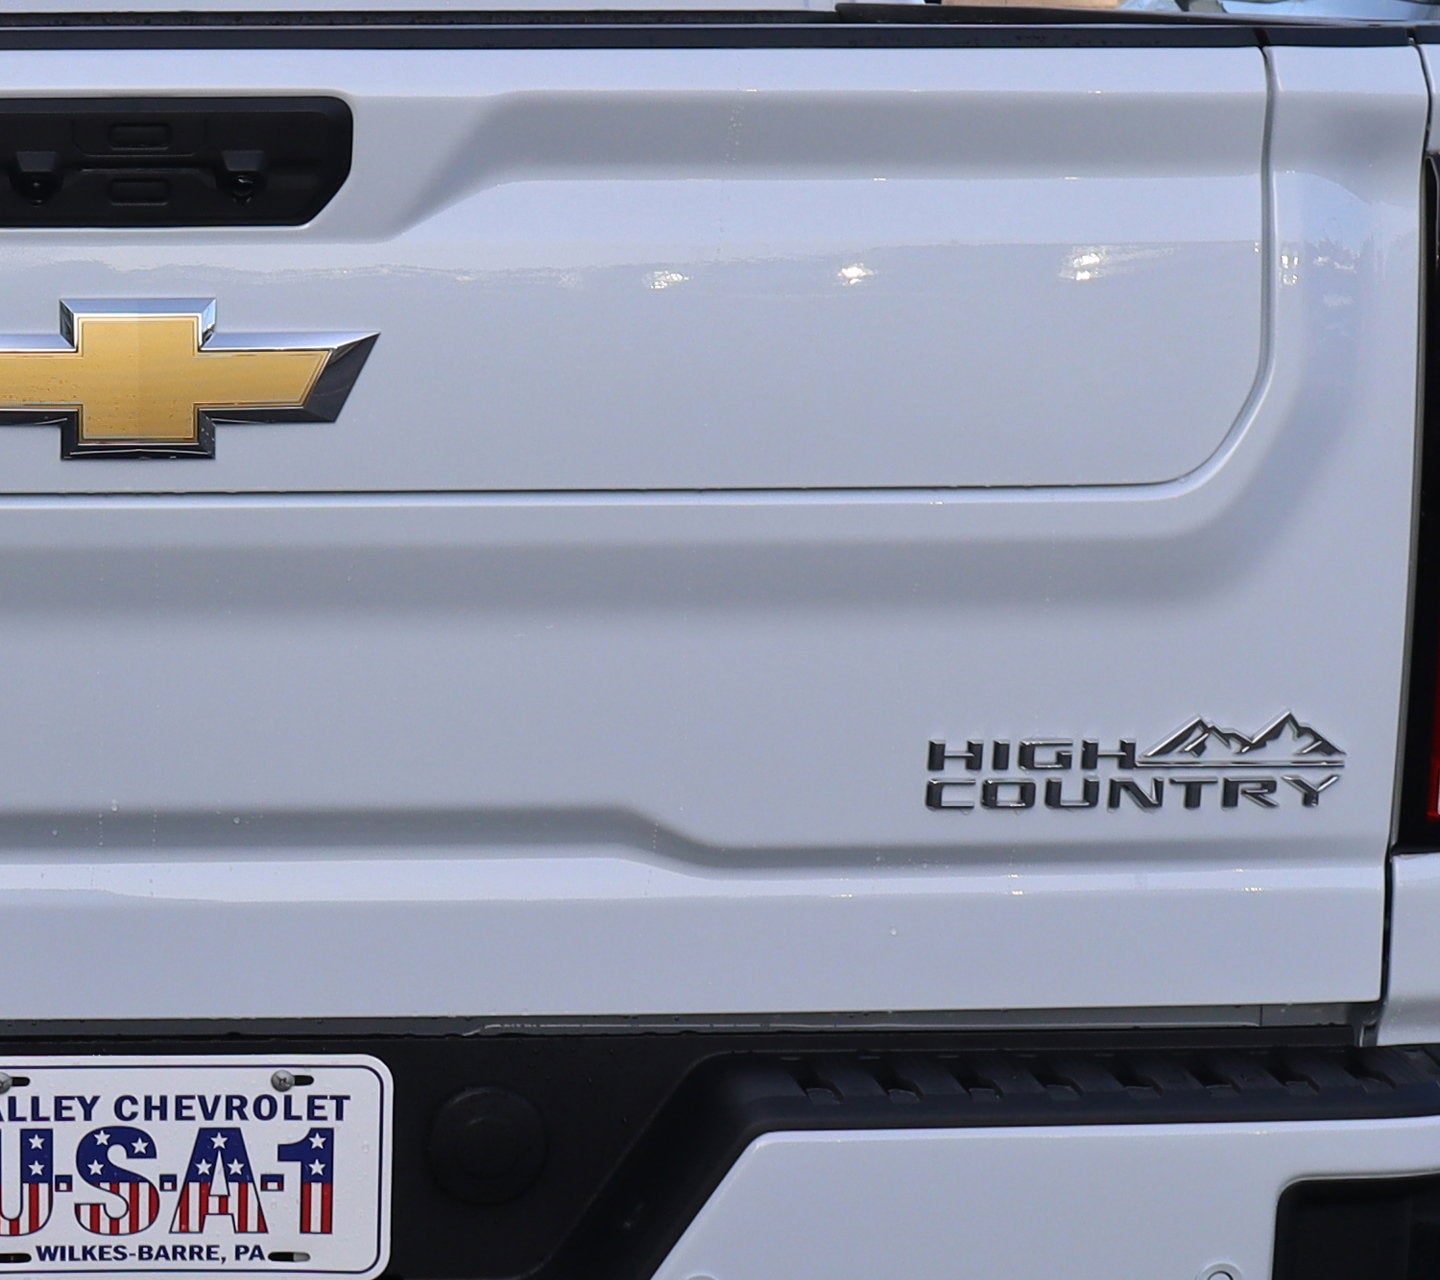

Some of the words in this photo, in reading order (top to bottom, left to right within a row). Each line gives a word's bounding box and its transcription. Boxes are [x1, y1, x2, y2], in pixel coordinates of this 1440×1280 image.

[928, 739, 1137, 771] HIGH
[925, 775, 1340, 810] COUNTRY
[114, 1094, 351, 1122] CHEVROLET
[35, 1244, 227, 1265] WILKES-BARRE,
[234, 1244, 266, 1262] PA
